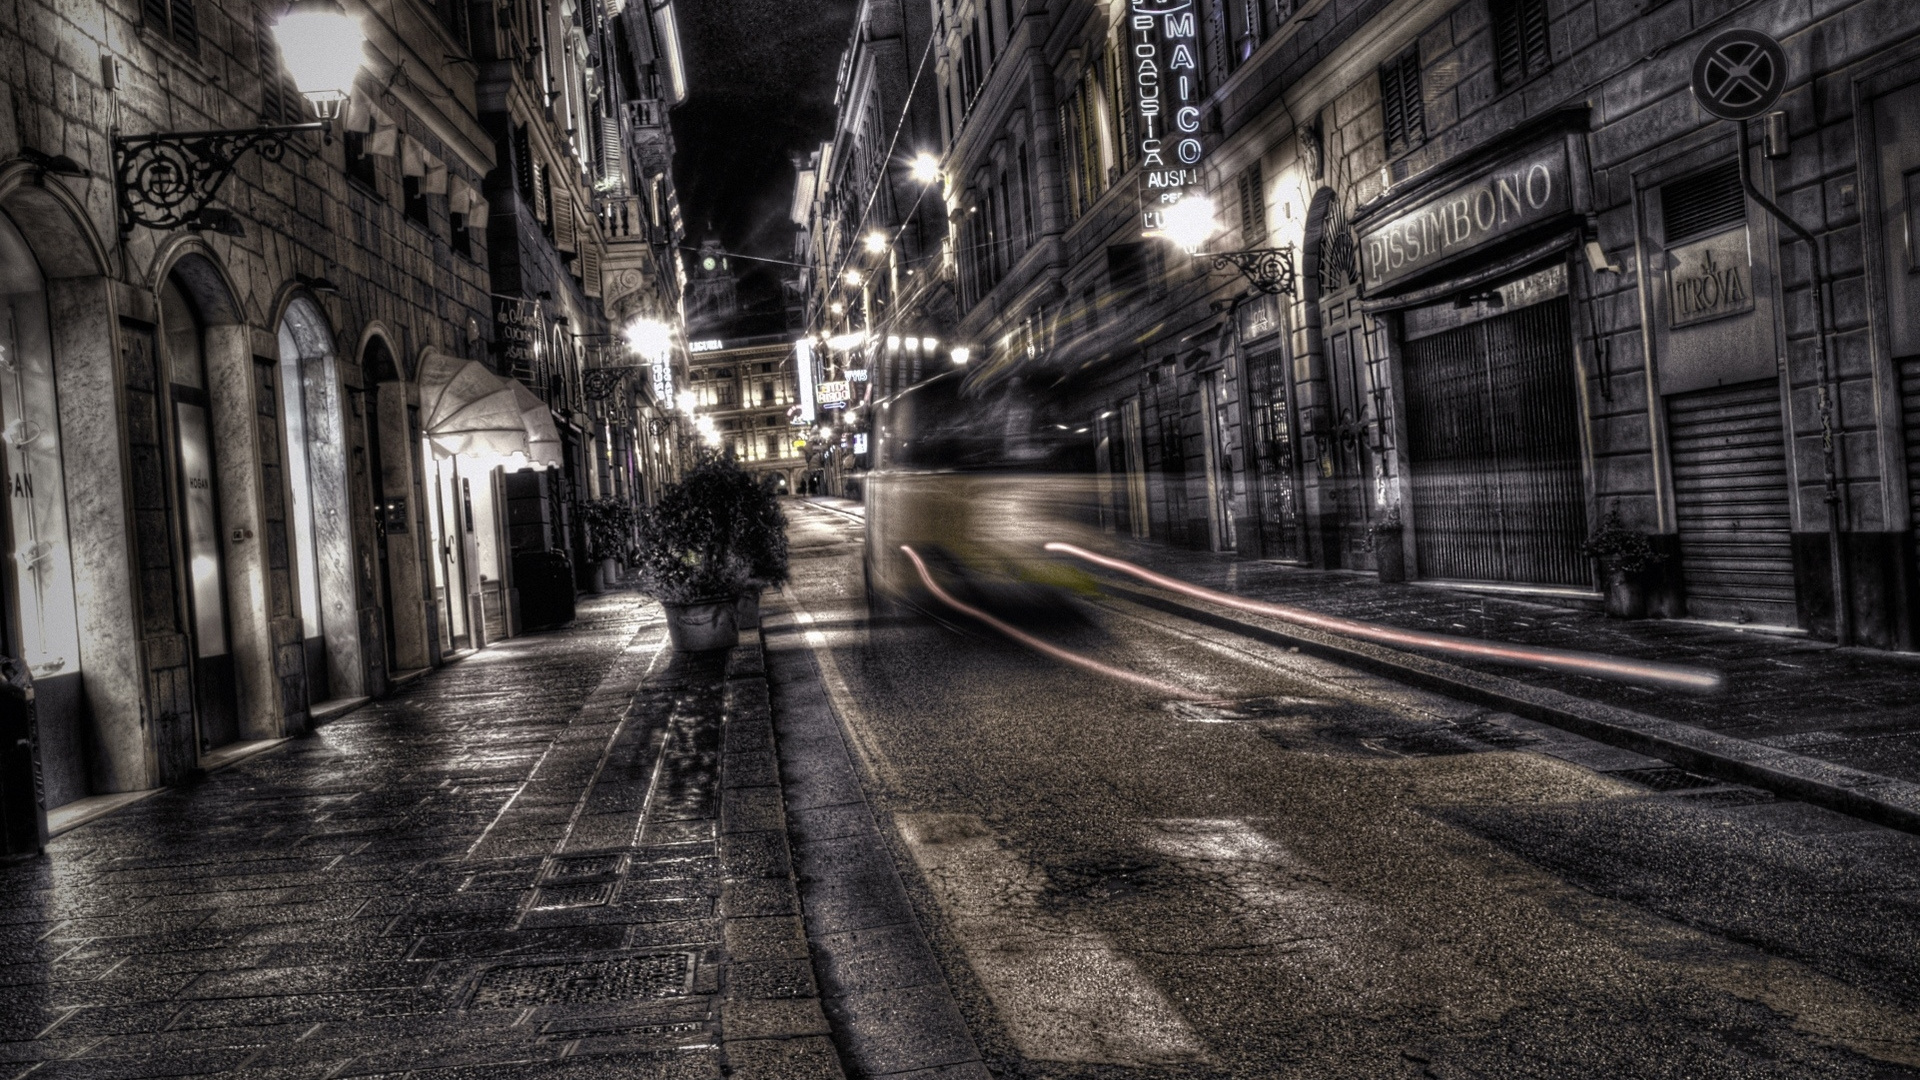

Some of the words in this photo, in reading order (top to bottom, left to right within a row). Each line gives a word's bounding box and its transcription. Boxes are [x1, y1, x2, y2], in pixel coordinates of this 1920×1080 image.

[1134, 15, 1163, 166] BIOACUSTICA
[1165, 13, 1201, 164] MAICO
[1370, 164, 1551, 278] PISSIMBONO
[1676, 267, 1746, 315] TROVA
[190, 477, 209, 489] HOGAN
